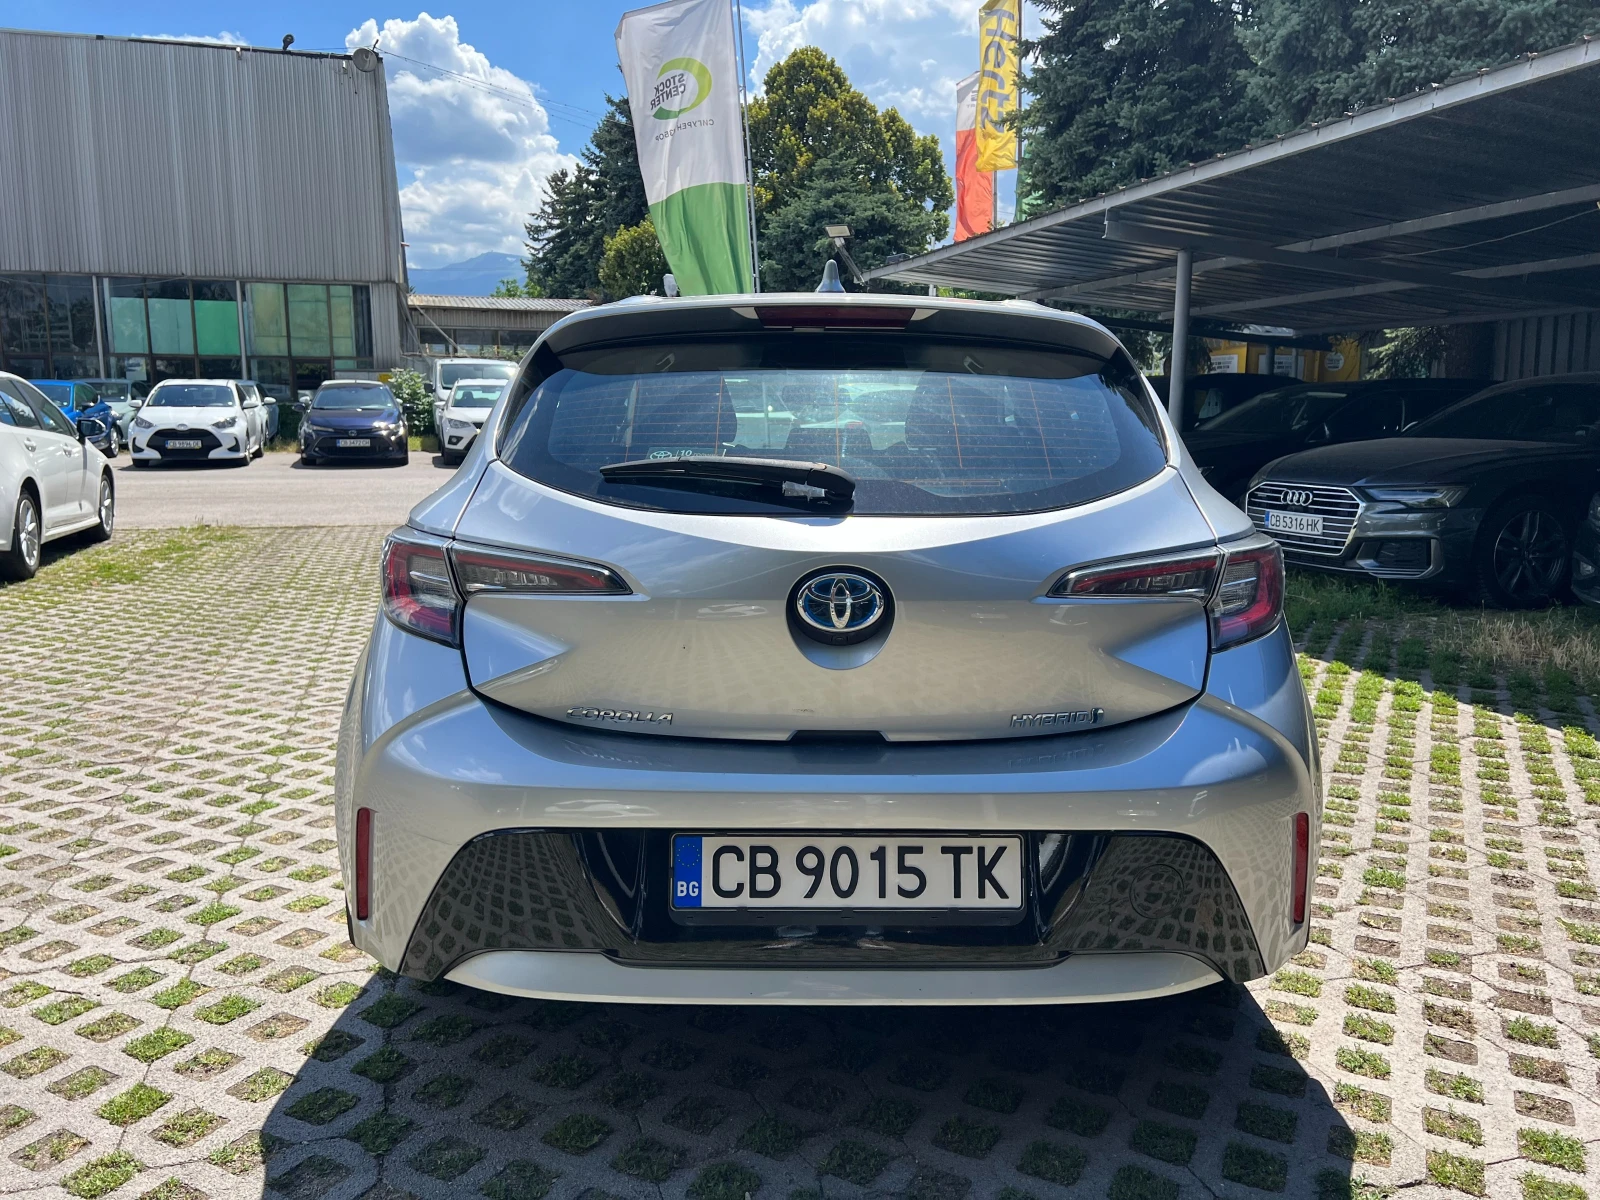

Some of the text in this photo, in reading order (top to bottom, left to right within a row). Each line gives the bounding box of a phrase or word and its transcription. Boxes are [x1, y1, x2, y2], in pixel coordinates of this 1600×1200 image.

[981, 9, 1017, 133] Hertz
[680, 449, 693, 457] 10
[1270, 514, 1320, 533] CB 5316 HK
[565, 706, 674, 725] COROLLA
[1009, 711, 1089, 728] HYBRID
[711, 845, 1010, 899] CB 9015 TK
[676, 881, 700, 897] BG
